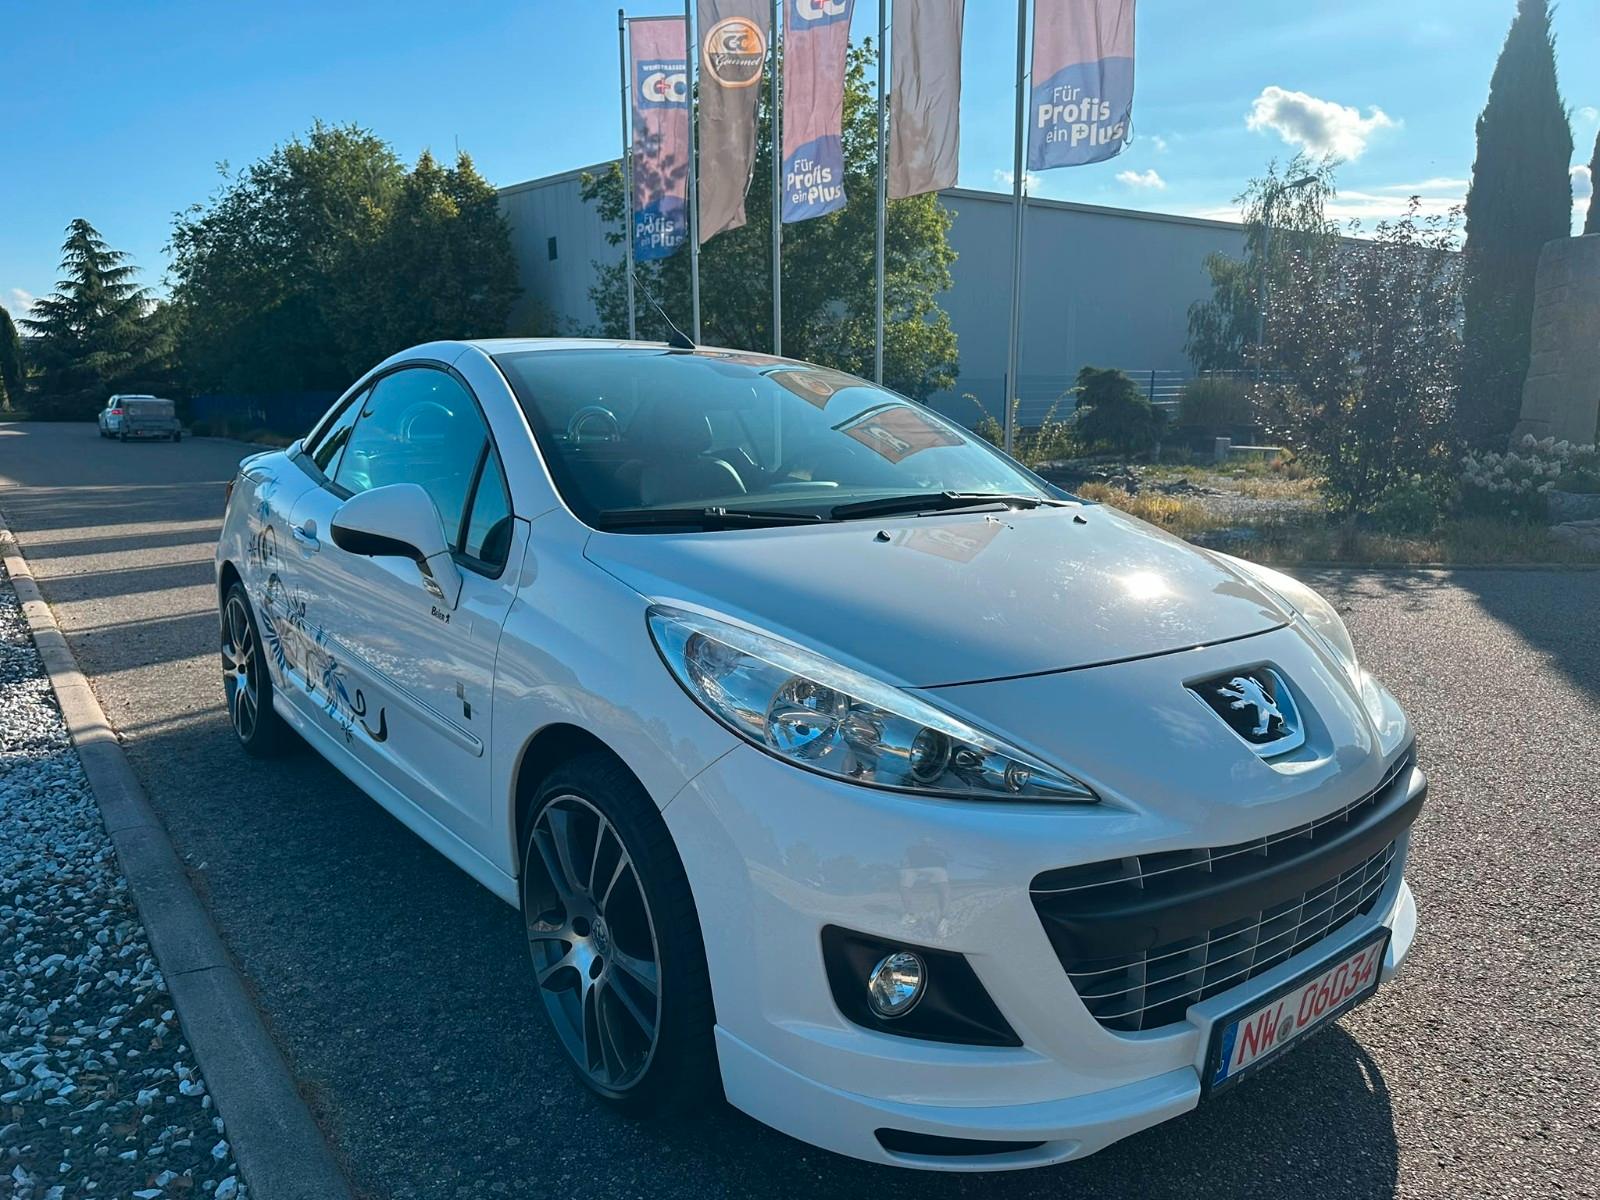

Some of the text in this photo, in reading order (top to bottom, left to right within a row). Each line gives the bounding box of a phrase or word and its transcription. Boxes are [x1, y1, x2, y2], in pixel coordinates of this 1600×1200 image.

[1053, 85, 1080, 103] Für
[1038, 97, 1110, 128] Profis
[1046, 121, 1124, 147] ein Plus
[794, 158, 814, 173] Für
[786, 165, 832, 191] Profis
[792, 184, 841, 205] ein Plus
[651, 233, 683, 249] Plus
[1237, 1002, 1284, 1066] NW
[1296, 945, 1379, 1029] 06034
